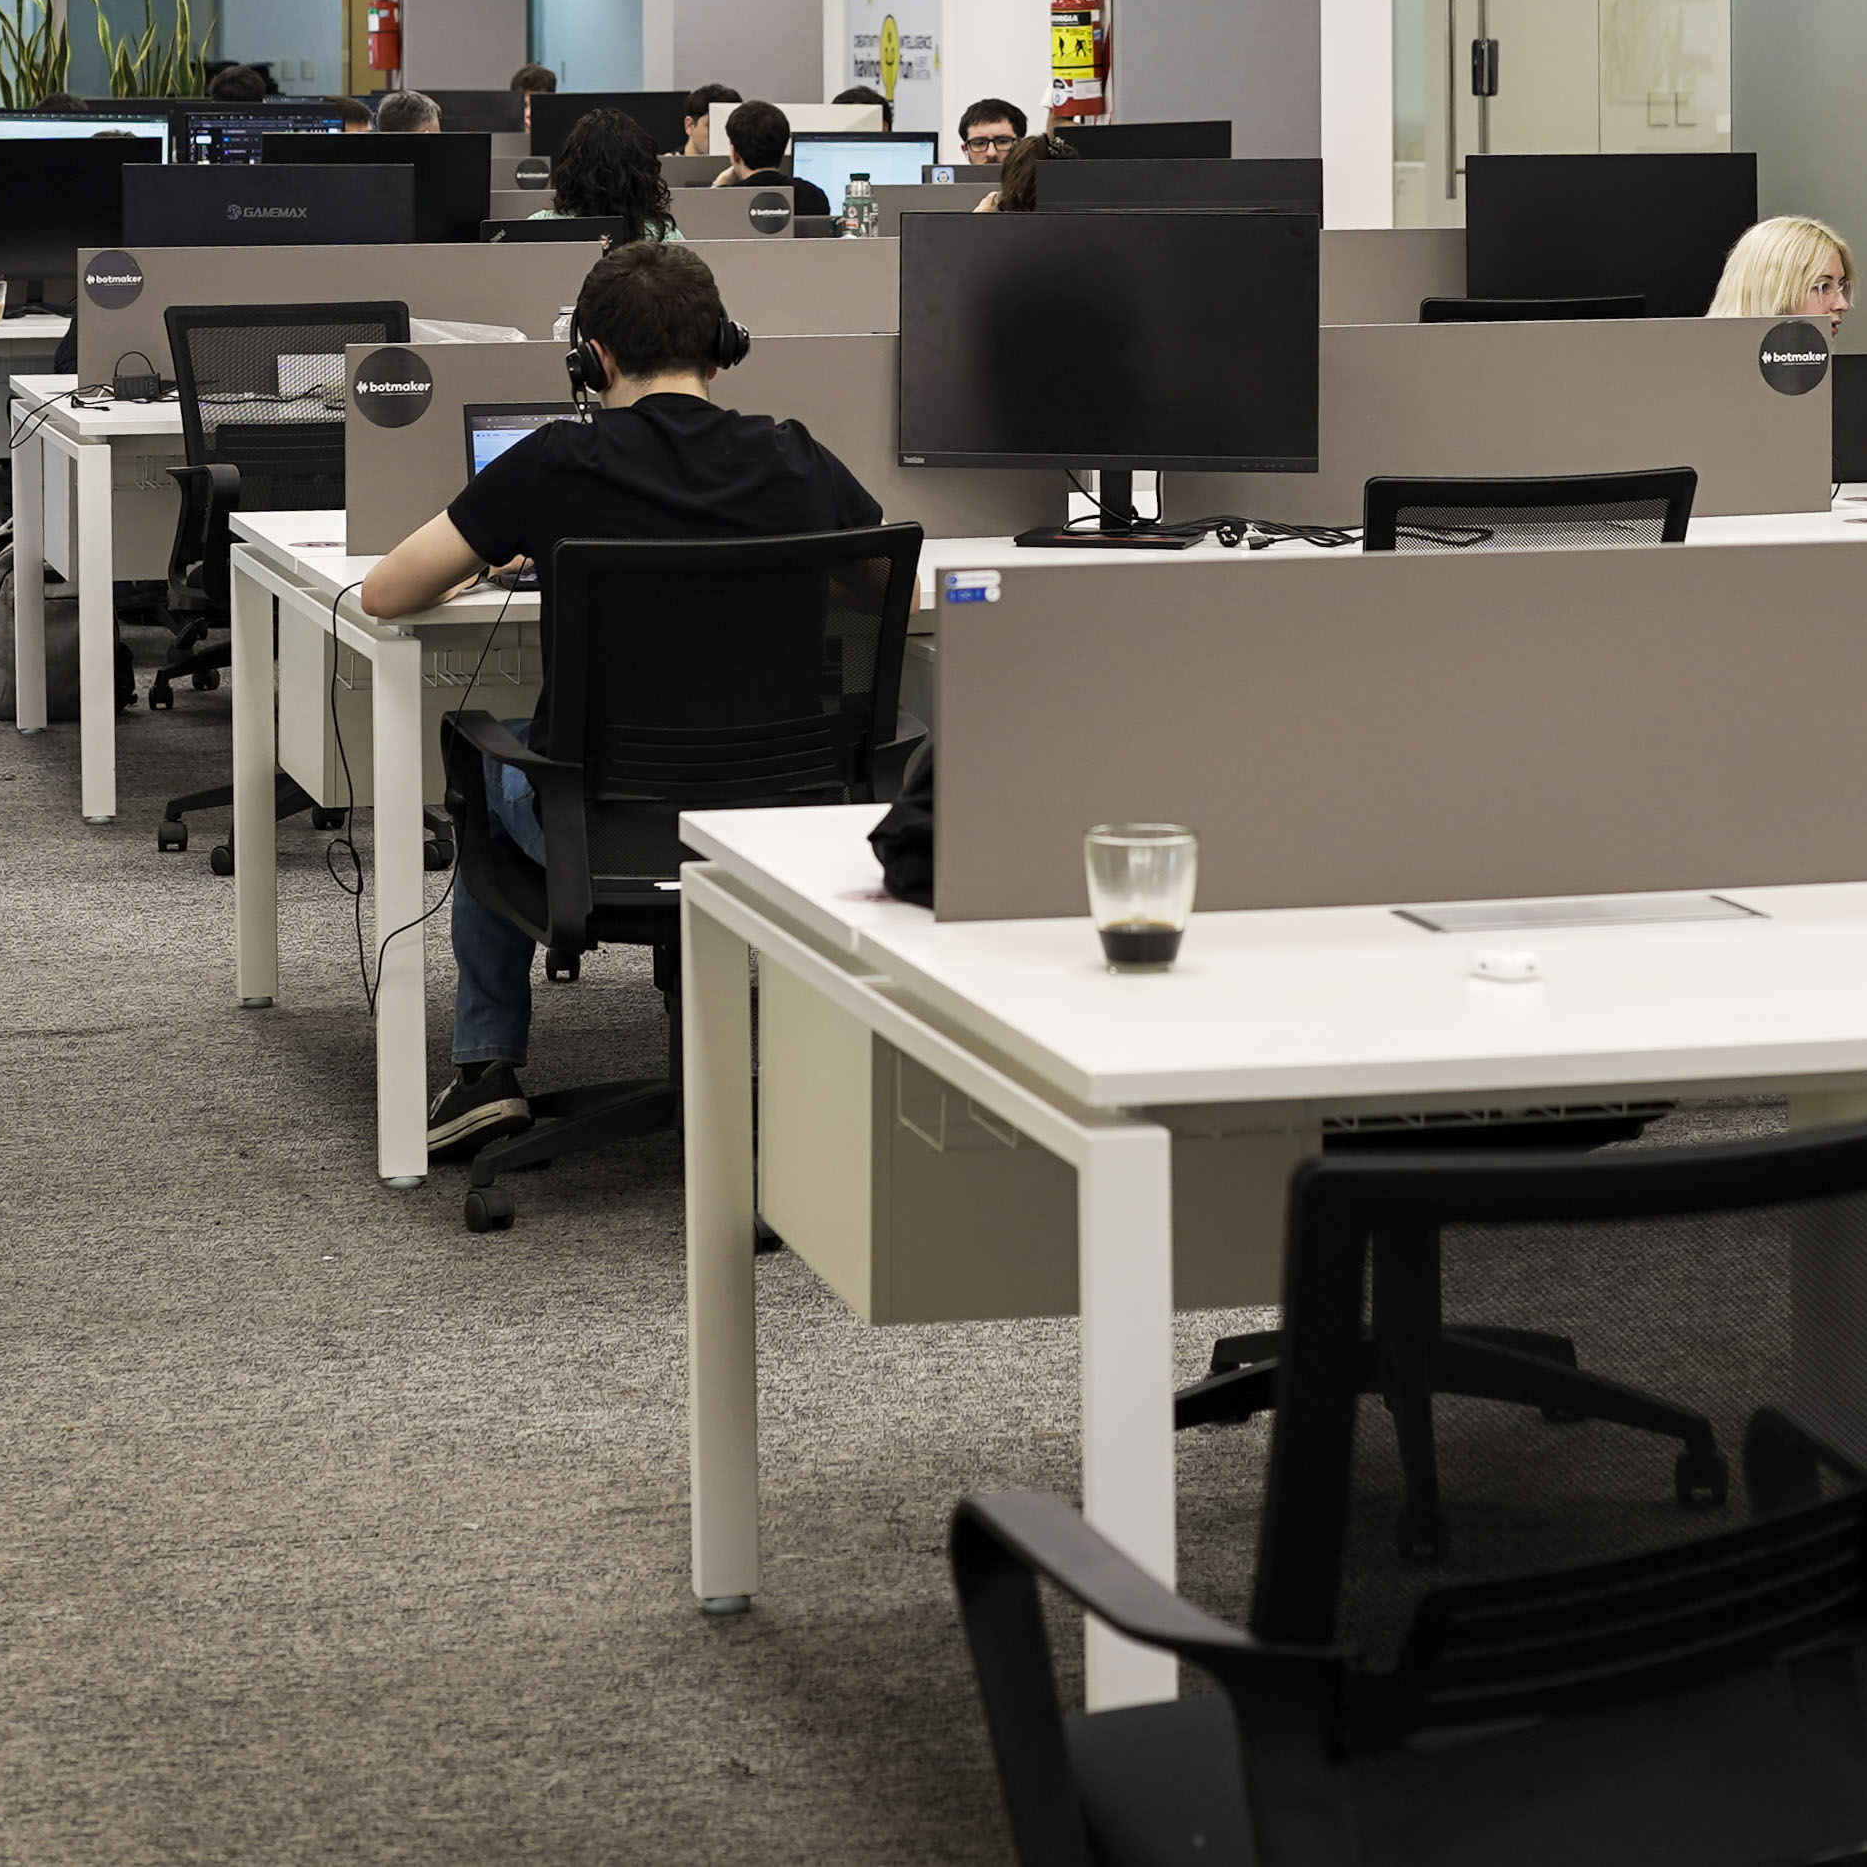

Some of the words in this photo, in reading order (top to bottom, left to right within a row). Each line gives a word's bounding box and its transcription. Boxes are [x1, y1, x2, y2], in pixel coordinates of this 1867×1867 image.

[243, 207, 308, 218] GAMEMAX
[96, 274, 143, 284] botmaker
[1773, 351, 1827, 363] botmaker
[369, 380, 431, 393] botmaker
